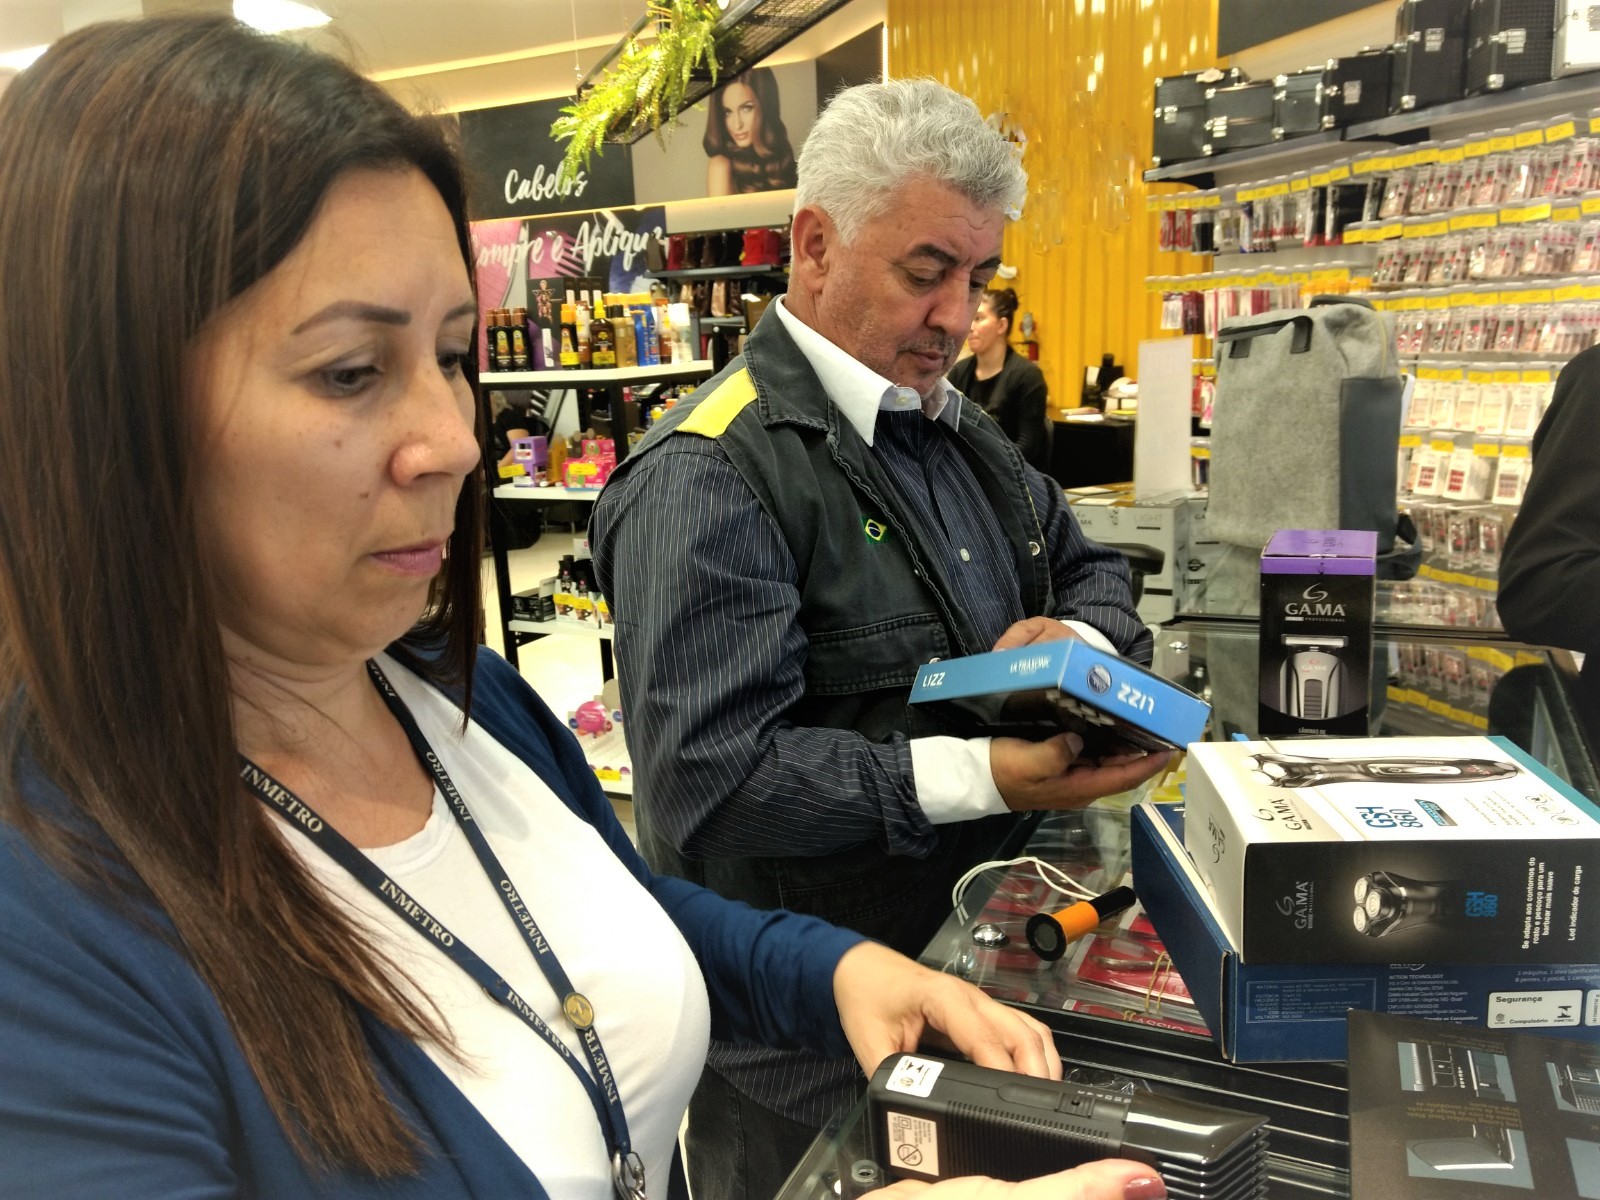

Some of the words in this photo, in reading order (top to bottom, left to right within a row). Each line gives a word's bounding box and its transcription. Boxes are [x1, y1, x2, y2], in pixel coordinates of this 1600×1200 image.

[473, 233, 544, 277] ompre
[1284, 602, 1346, 616] GA.MA
[922, 672, 946, 688] LIZZ
[1117, 682, 1155, 715] LIZZ
[240, 764, 324, 833] INMETRO
[425, 751, 473, 822] INMETRO
[1355, 806, 1398, 828] GSH
[1388, 808, 1423, 828] 860
[1528, 857, 1536, 866] do
[1538, 862, 1545, 874] um
[1527, 867, 1535, 902] contornos
[1537, 874, 1545, 890] para
[1574, 865, 1583, 885] carga
[1572, 886, 1580, 895] de
[378, 878, 455, 947] INMETRO
[1294, 881, 1308, 929] GA.MA
[1466, 892, 1484, 917] GSH
[1484, 894, 1498, 918] 860
[1535, 891, 1544, 920] pescoço
[1569, 896, 1579, 927] indicador
[500, 879, 549, 956] INMETRO
[1523, 916, 1532, 939] adapta
[1542, 910, 1551, 936] barbear
[1521, 940, 1530, 949] Se
[1568, 928, 1576, 941] Led
[1495, 996, 1543, 1004] Segurança
[506, 988, 572, 1059] INMETRO
[584, 1027, 619, 1106] INMETR
